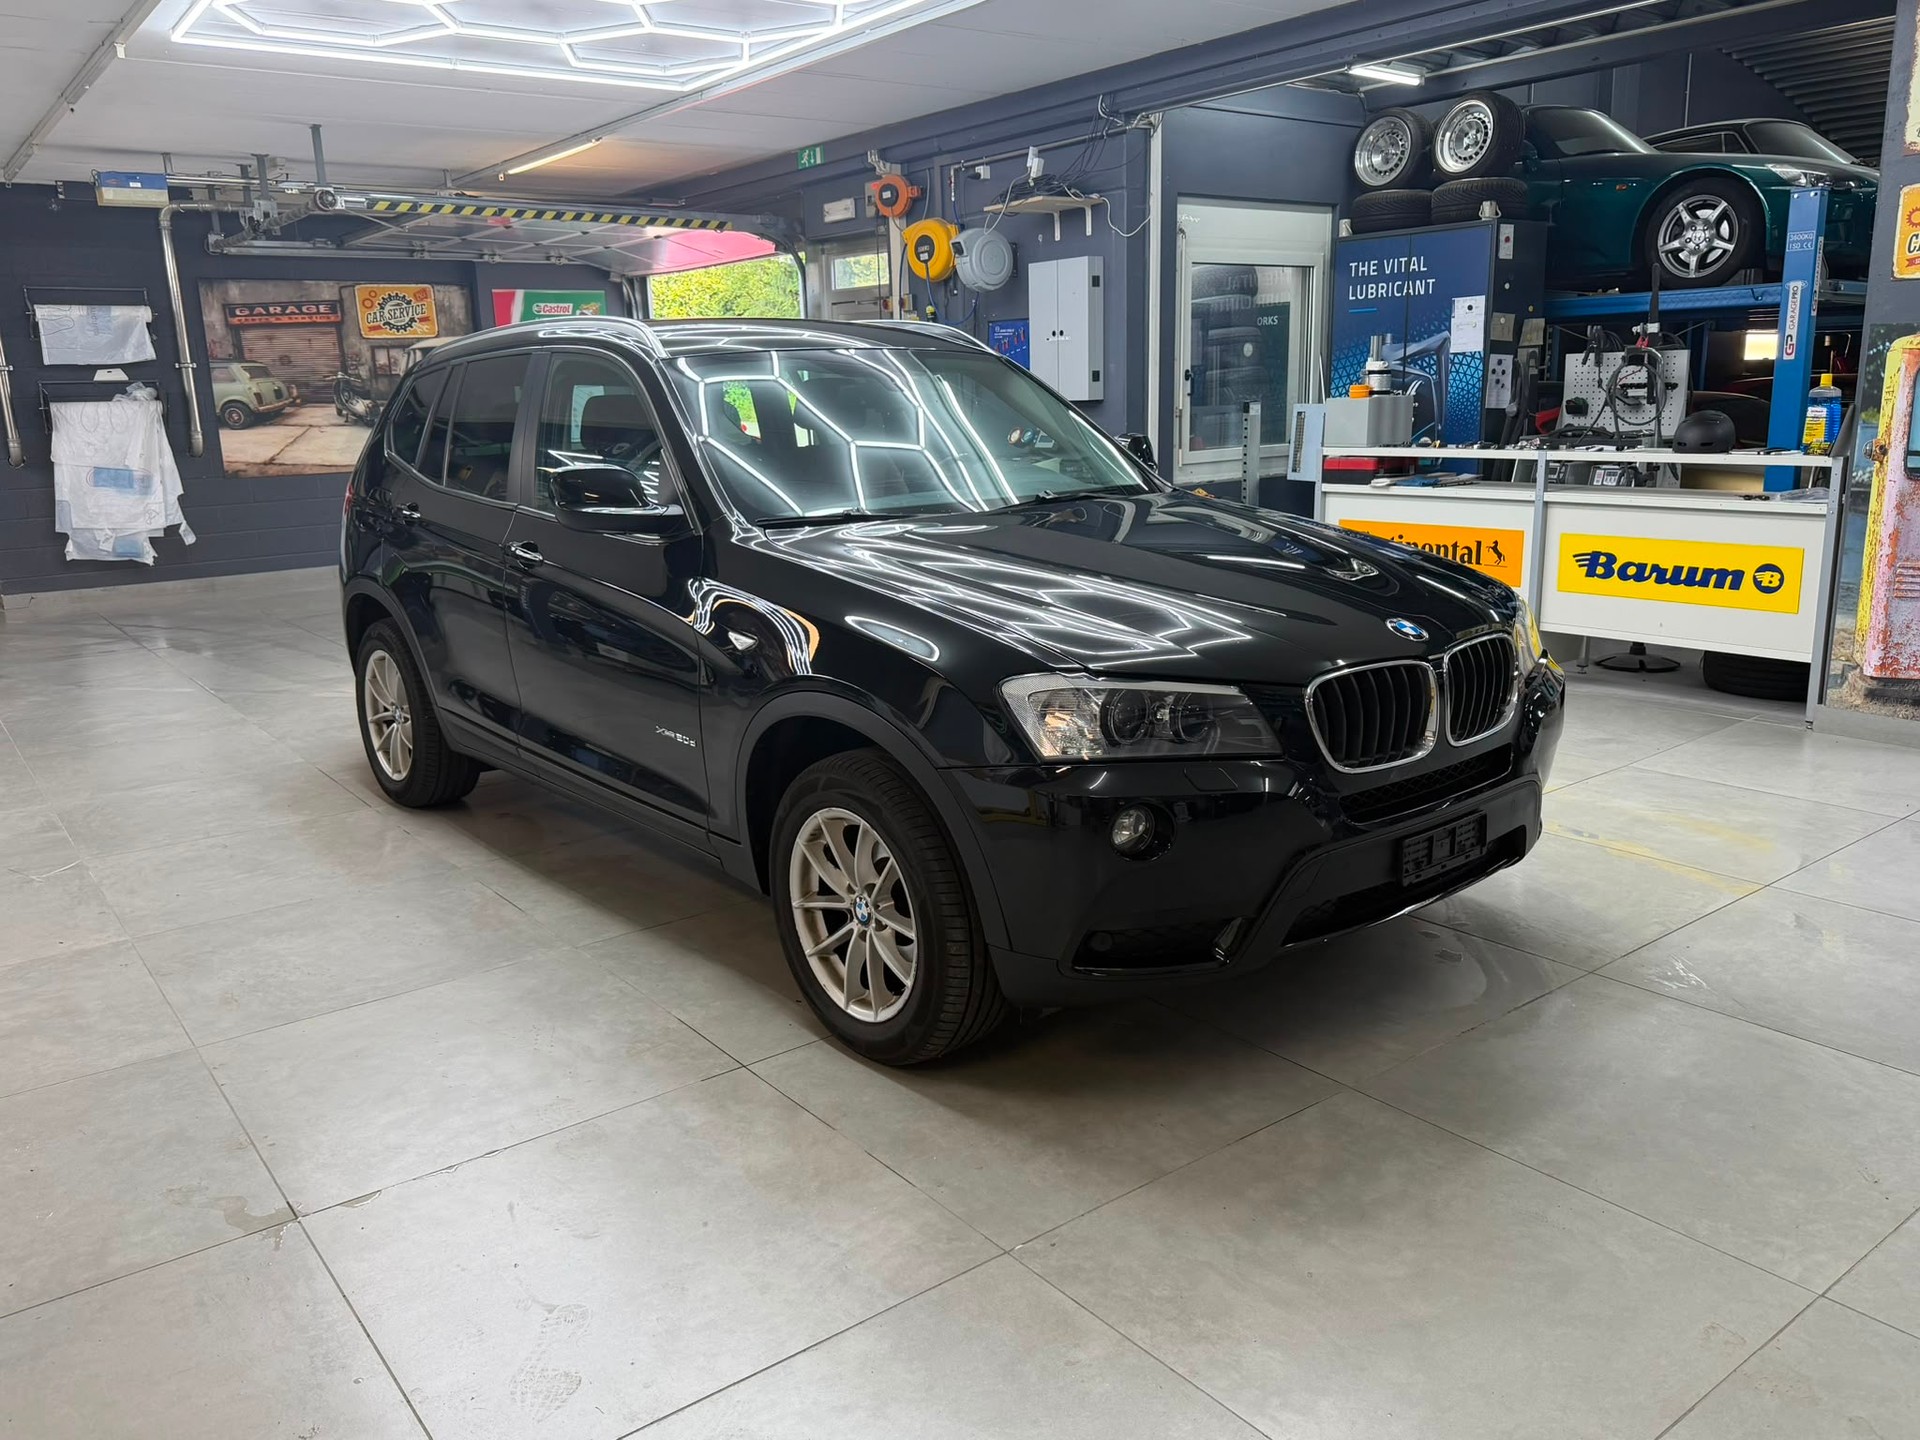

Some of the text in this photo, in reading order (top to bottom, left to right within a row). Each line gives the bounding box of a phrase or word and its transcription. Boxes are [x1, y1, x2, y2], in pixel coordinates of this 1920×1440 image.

[1350, 256, 1427, 277] THE VITAL
[1349, 279, 1436, 300] LUBRICANT
[235, 304, 333, 316] GARAGE
[366, 303, 427, 324] CAR SERVICE
[542, 304, 570, 314] Castrol
[1572, 551, 1746, 591] Barum
